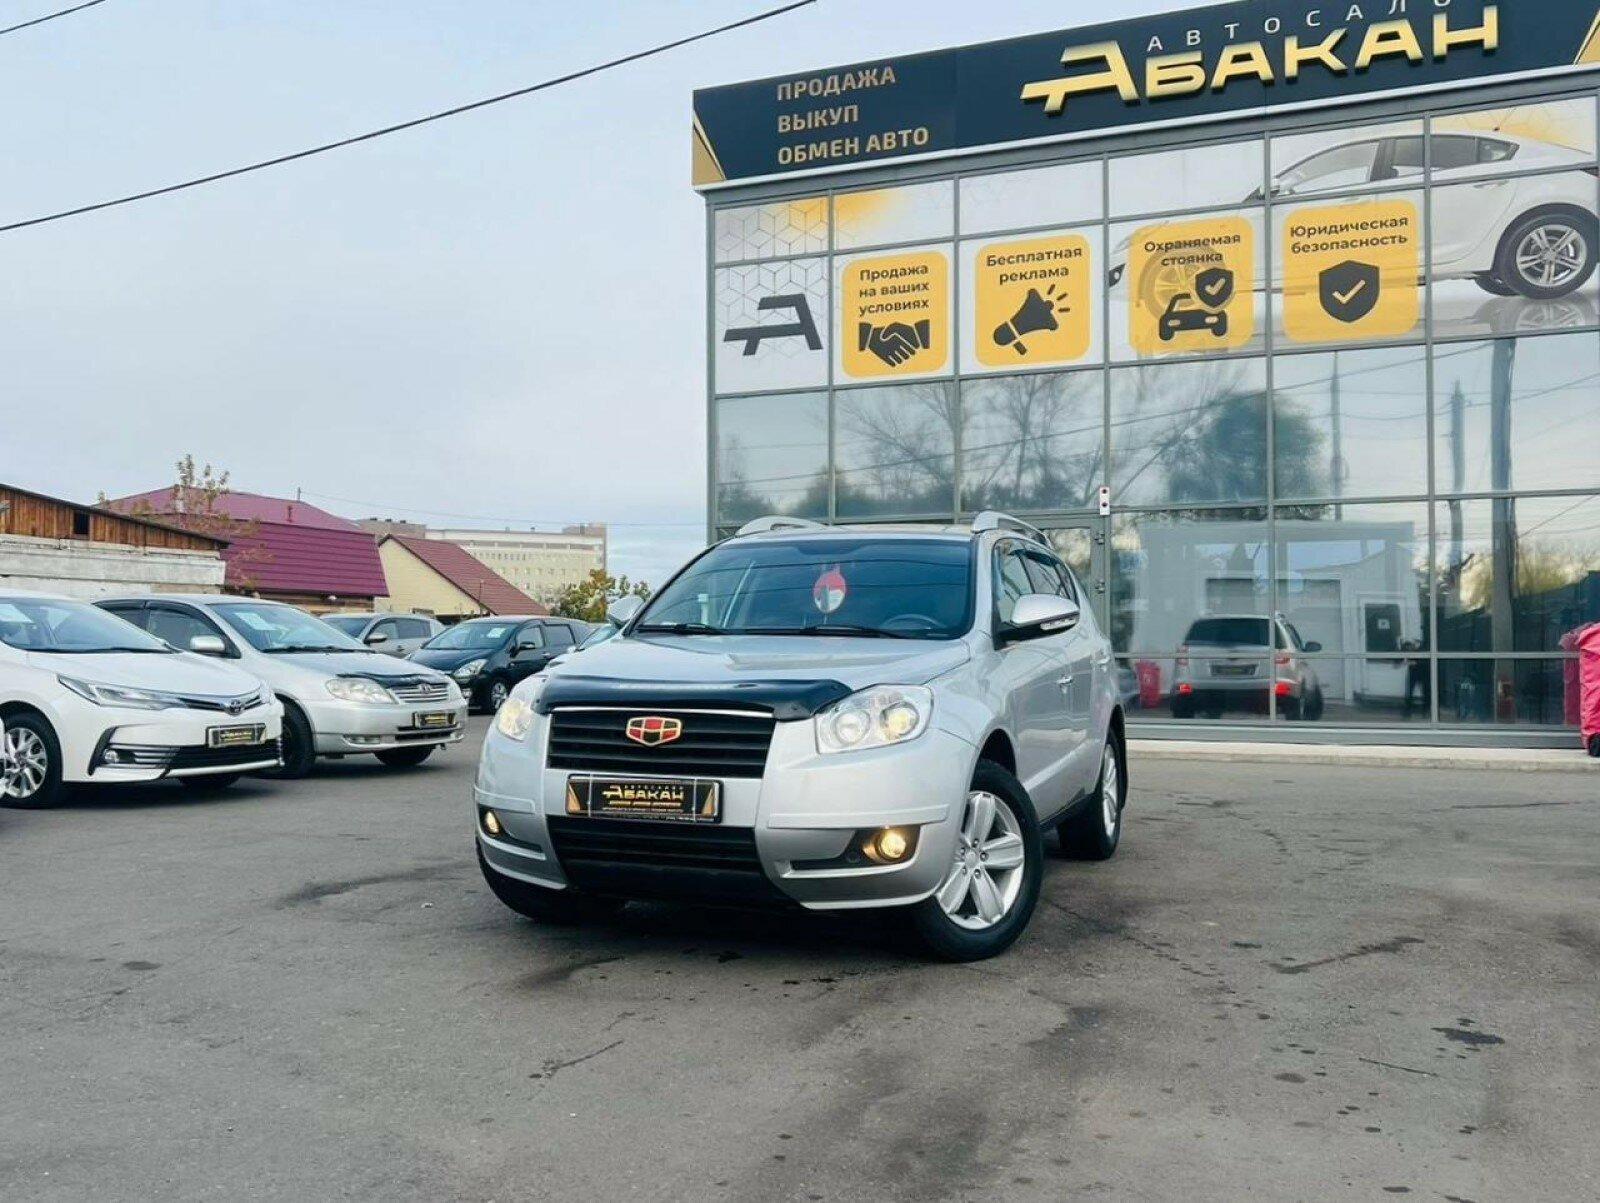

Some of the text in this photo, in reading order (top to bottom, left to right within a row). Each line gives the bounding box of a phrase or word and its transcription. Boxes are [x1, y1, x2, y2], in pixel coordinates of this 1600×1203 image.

[1021, 5, 1499, 113] АБАКАН
[777, 66, 896, 101] ПРОДАЖА
[777, 104, 859, 134] ВЫКУП
[778, 126, 929, 165] ОБМЕН АВТО
[1290, 217, 1408, 238] Юридическая
[1144, 234, 1241, 252] Охраняемая
[1290, 235, 1408, 254] безопасность
[986, 248, 1082, 267] Бесплатная
[1161, 253, 1224, 267] стоянка
[860, 265, 929, 283] Продажа
[999, 267, 1070, 286] реклама
[859, 281, 930, 298] на ваших
[859, 299, 930, 318] условиях
